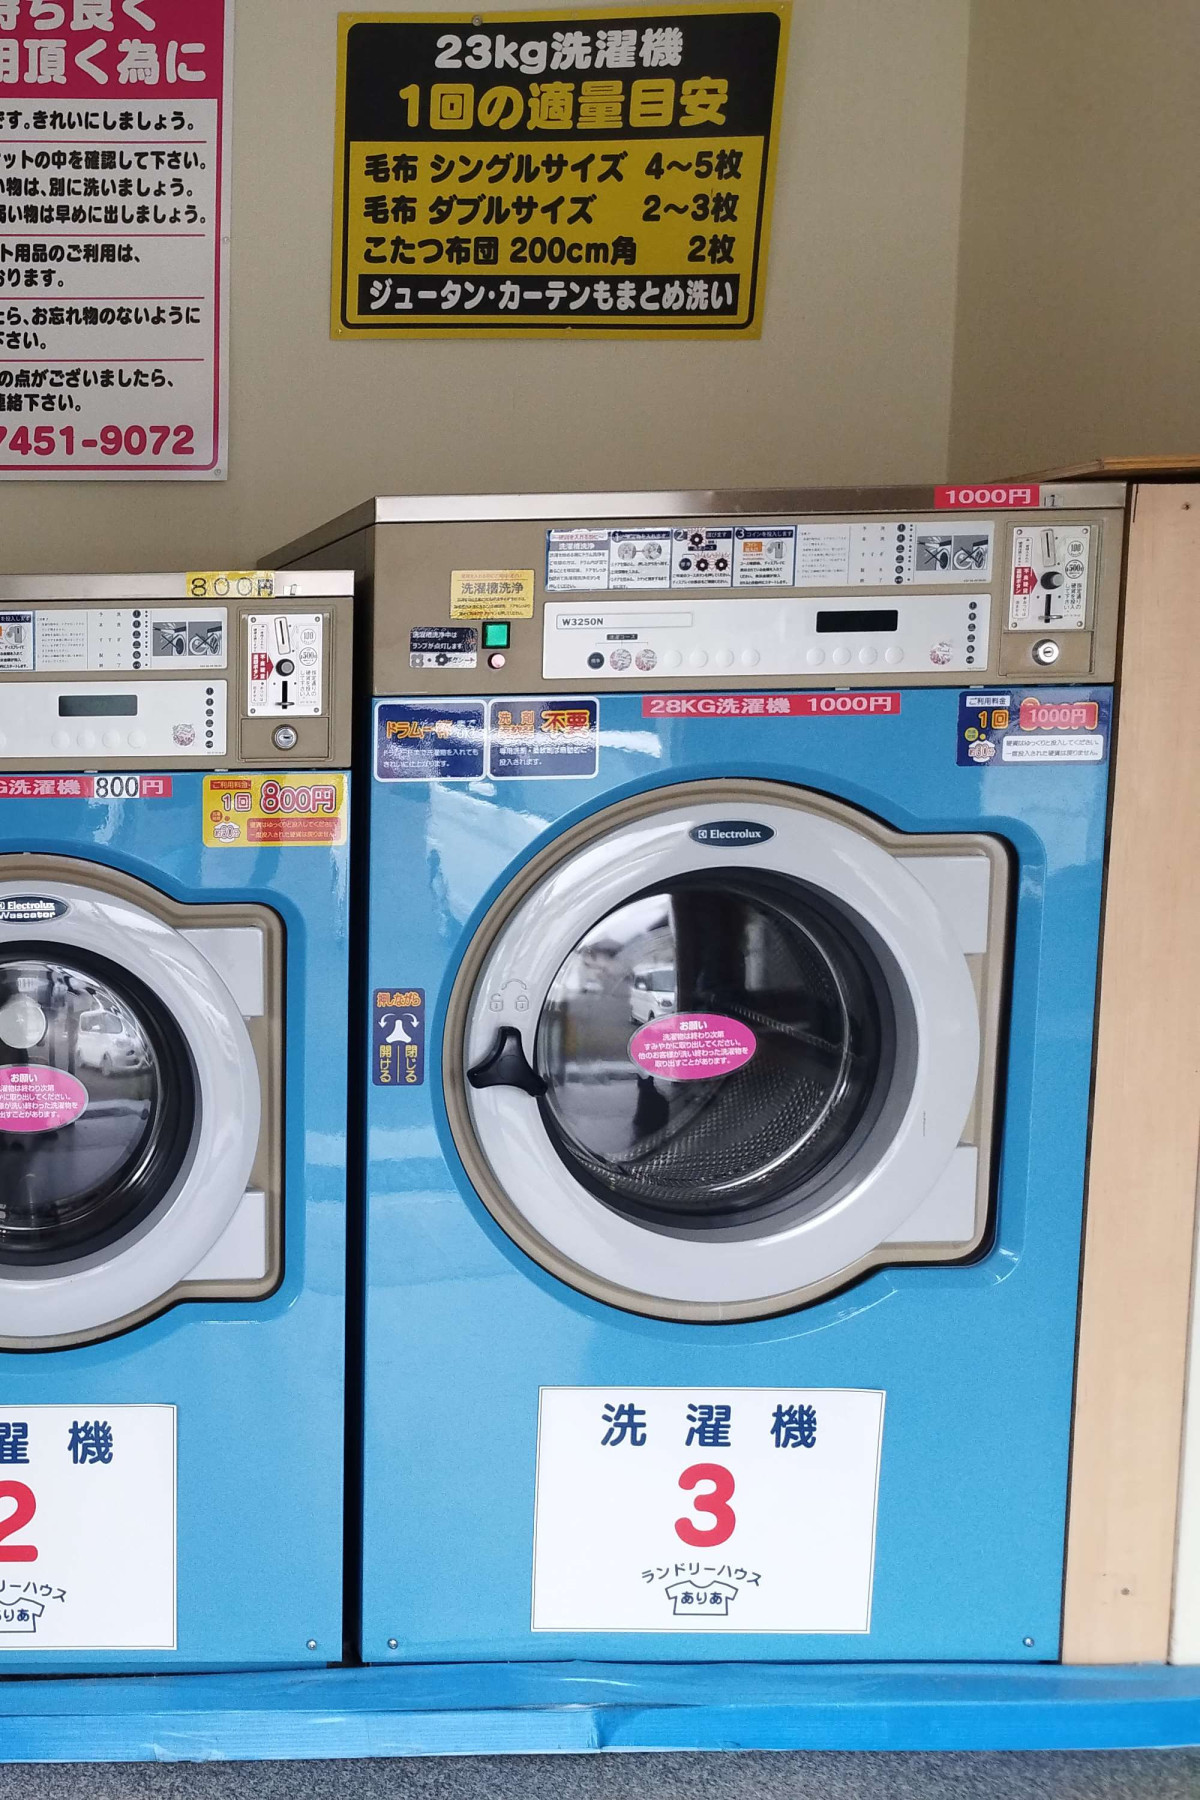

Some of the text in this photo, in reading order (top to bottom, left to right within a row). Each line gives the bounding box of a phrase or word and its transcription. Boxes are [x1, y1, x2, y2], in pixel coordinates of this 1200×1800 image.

[434, 26, 684, 75] 23kg洗濯機
[398, 75, 729, 131] 1回の適量目安
[363, 153, 418, 184] 毛布
[429, 150, 628, 184] シングルサイズ
[362, 195, 417, 225] 毛布
[428, 193, 597, 226] ダブルサイズ
[363, 234, 736, 265] こたつ布団 200cm角 2枚
[945, 488, 1031, 505] 1000円
[561, 618, 604, 626] W3250N
[650, 697, 892, 714] 28KG洗濯機 1000円
[978, 708, 1087, 729] 1回 1000円
[221, 779, 337, 814] 1回 800円
[710, 829, 762, 839] Electrolux
[7, 901, 56, 910] Electrolux
[376, 991, 422, 1008] 押しながら
[679, 1020, 708, 1031] お願い
[379, 1045, 393, 1083] 開ける
[404, 1045, 418, 1083] 閉じる
[10, 1073, 38, 1083] お願い
[601, 1403, 818, 1449] 洗濯機
[674, 1462, 737, 1548] 3
[641, 1562, 763, 1587] ランドリーハウス
[680, 1590, 723, 1605] ありあ
